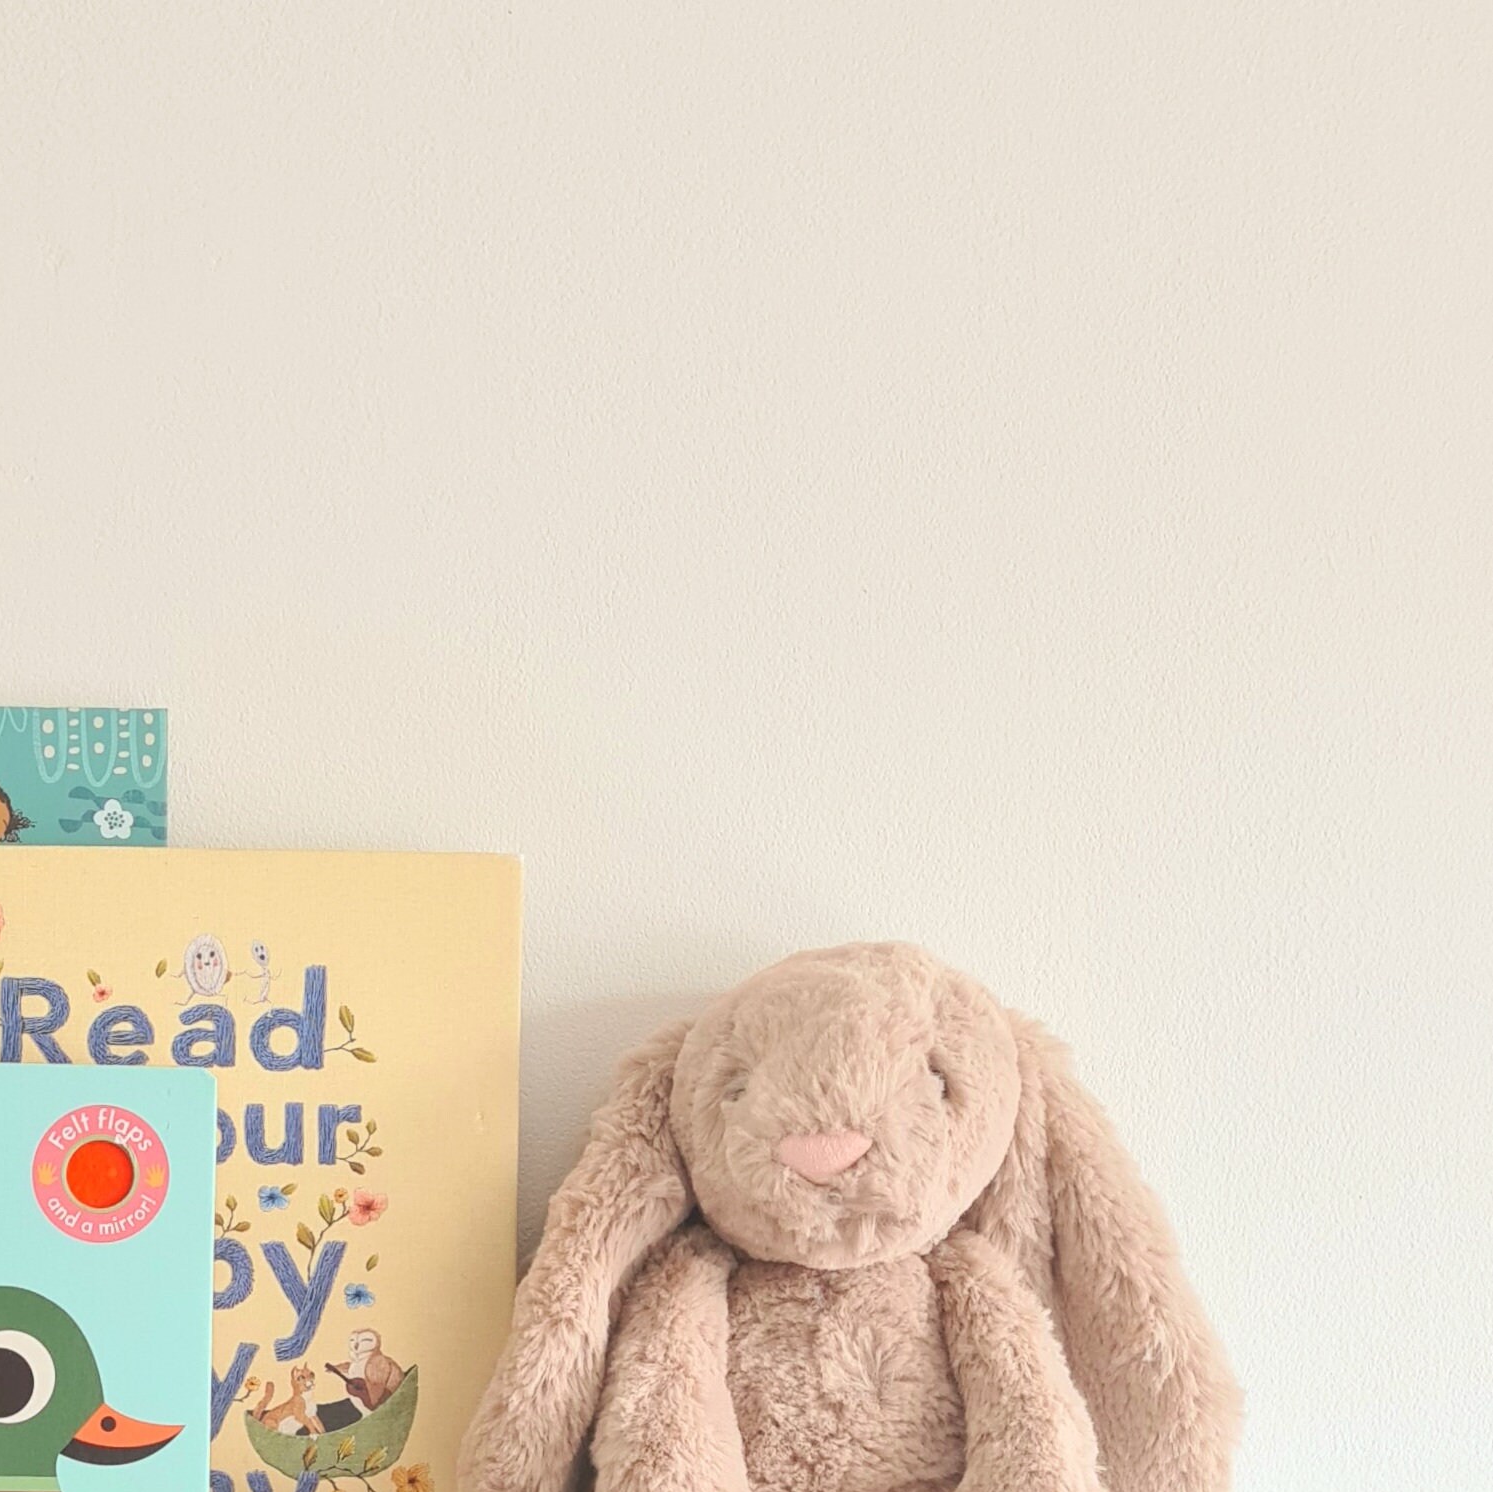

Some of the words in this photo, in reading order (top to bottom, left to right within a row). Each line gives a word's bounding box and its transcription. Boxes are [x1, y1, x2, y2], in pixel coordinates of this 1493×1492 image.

[0, 965, 328, 1071] Read
[47, 1112, 90, 1151] Felt
[97, 1107, 153, 1152] flaps
[47, 1197, 82, 1228] and
[80, 1222, 94, 1235] a
[98, 1193, 157, 1236] mirror!
